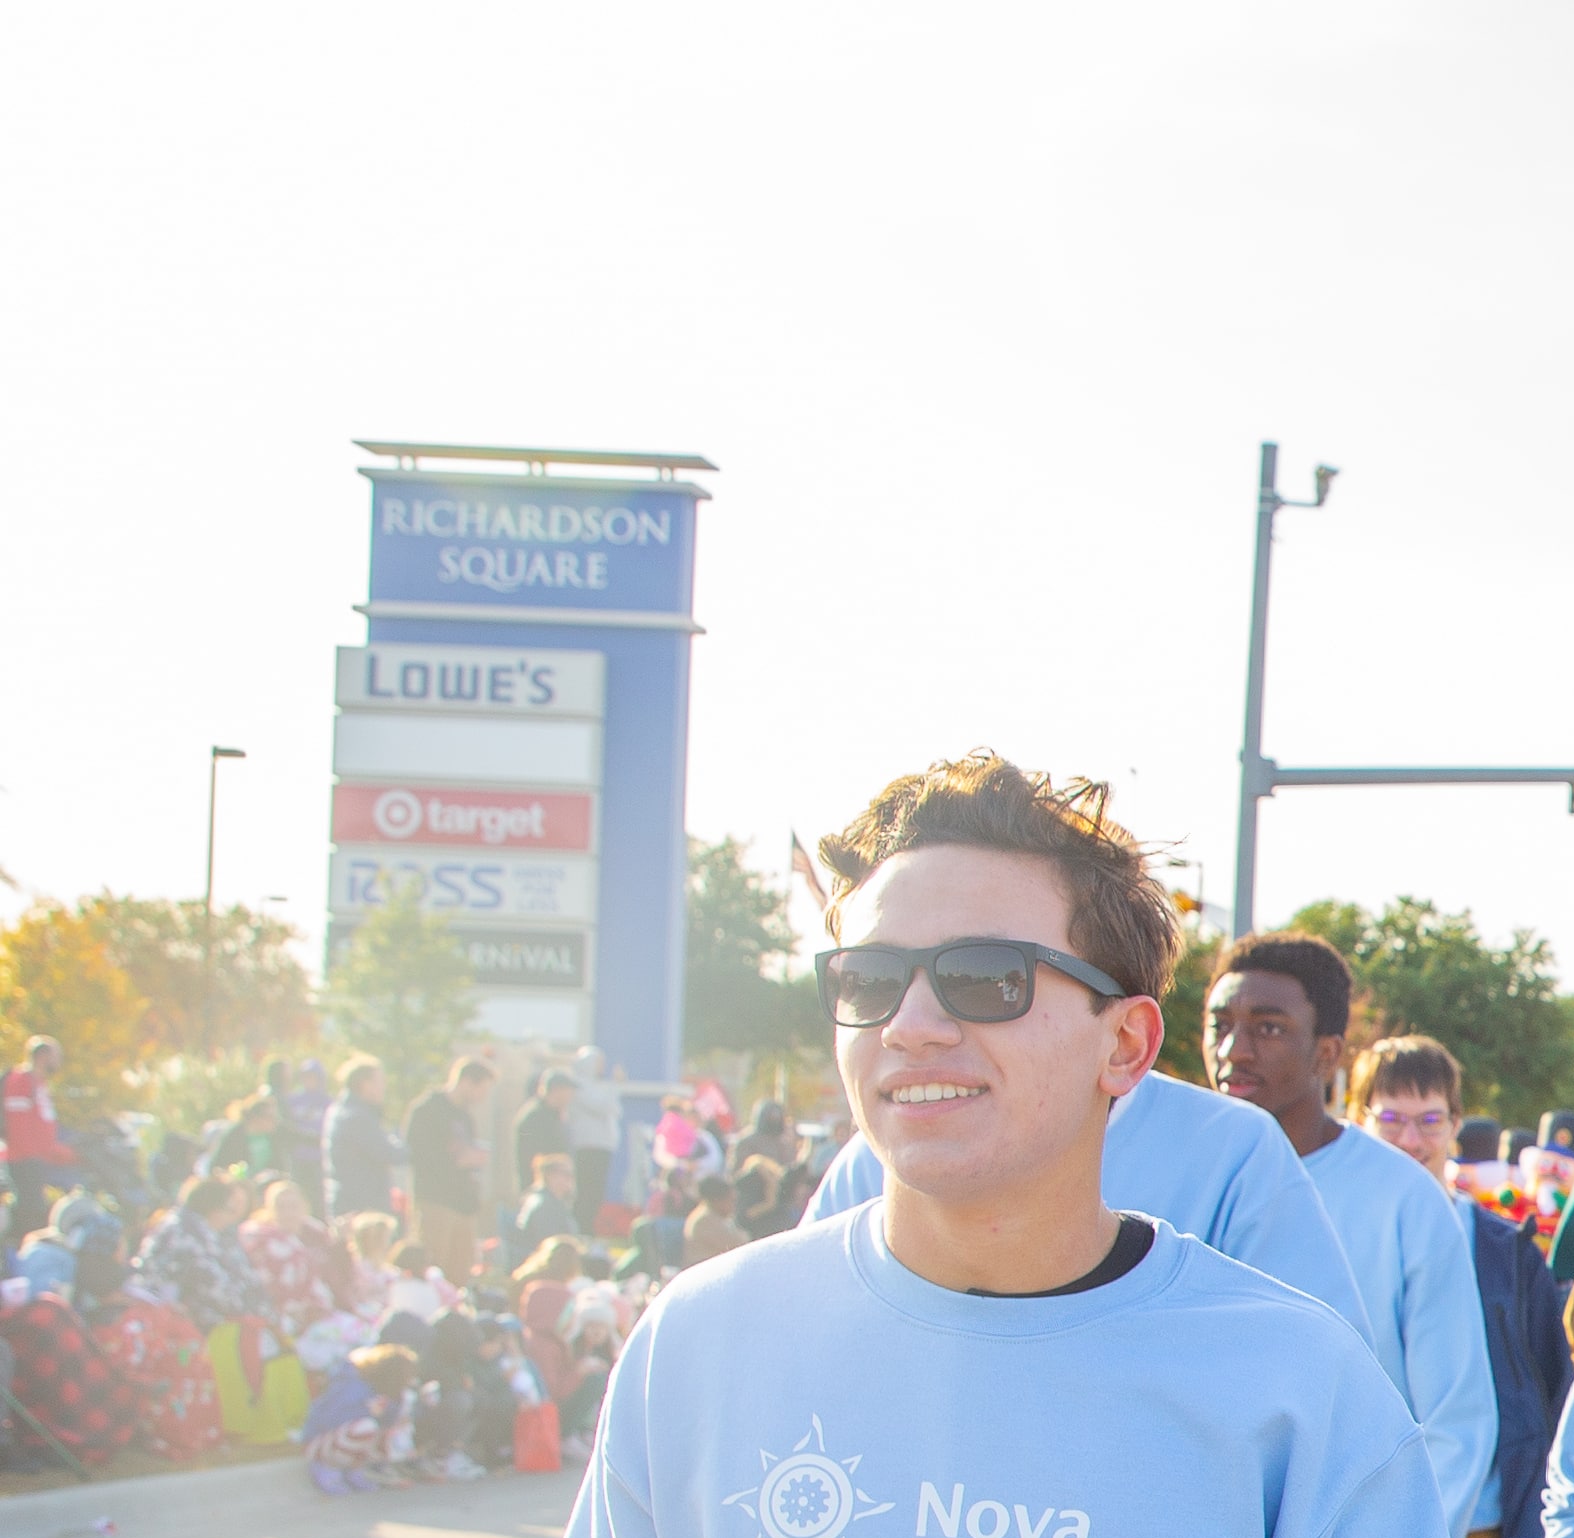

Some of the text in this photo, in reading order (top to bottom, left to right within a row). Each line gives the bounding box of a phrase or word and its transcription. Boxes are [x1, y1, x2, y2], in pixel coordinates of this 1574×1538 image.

[381, 497, 672, 545] RICHARDSON
[437, 545, 609, 593] SQUARE
[366, 653, 556, 705] LOWE'S
[428, 798, 545, 842] target
